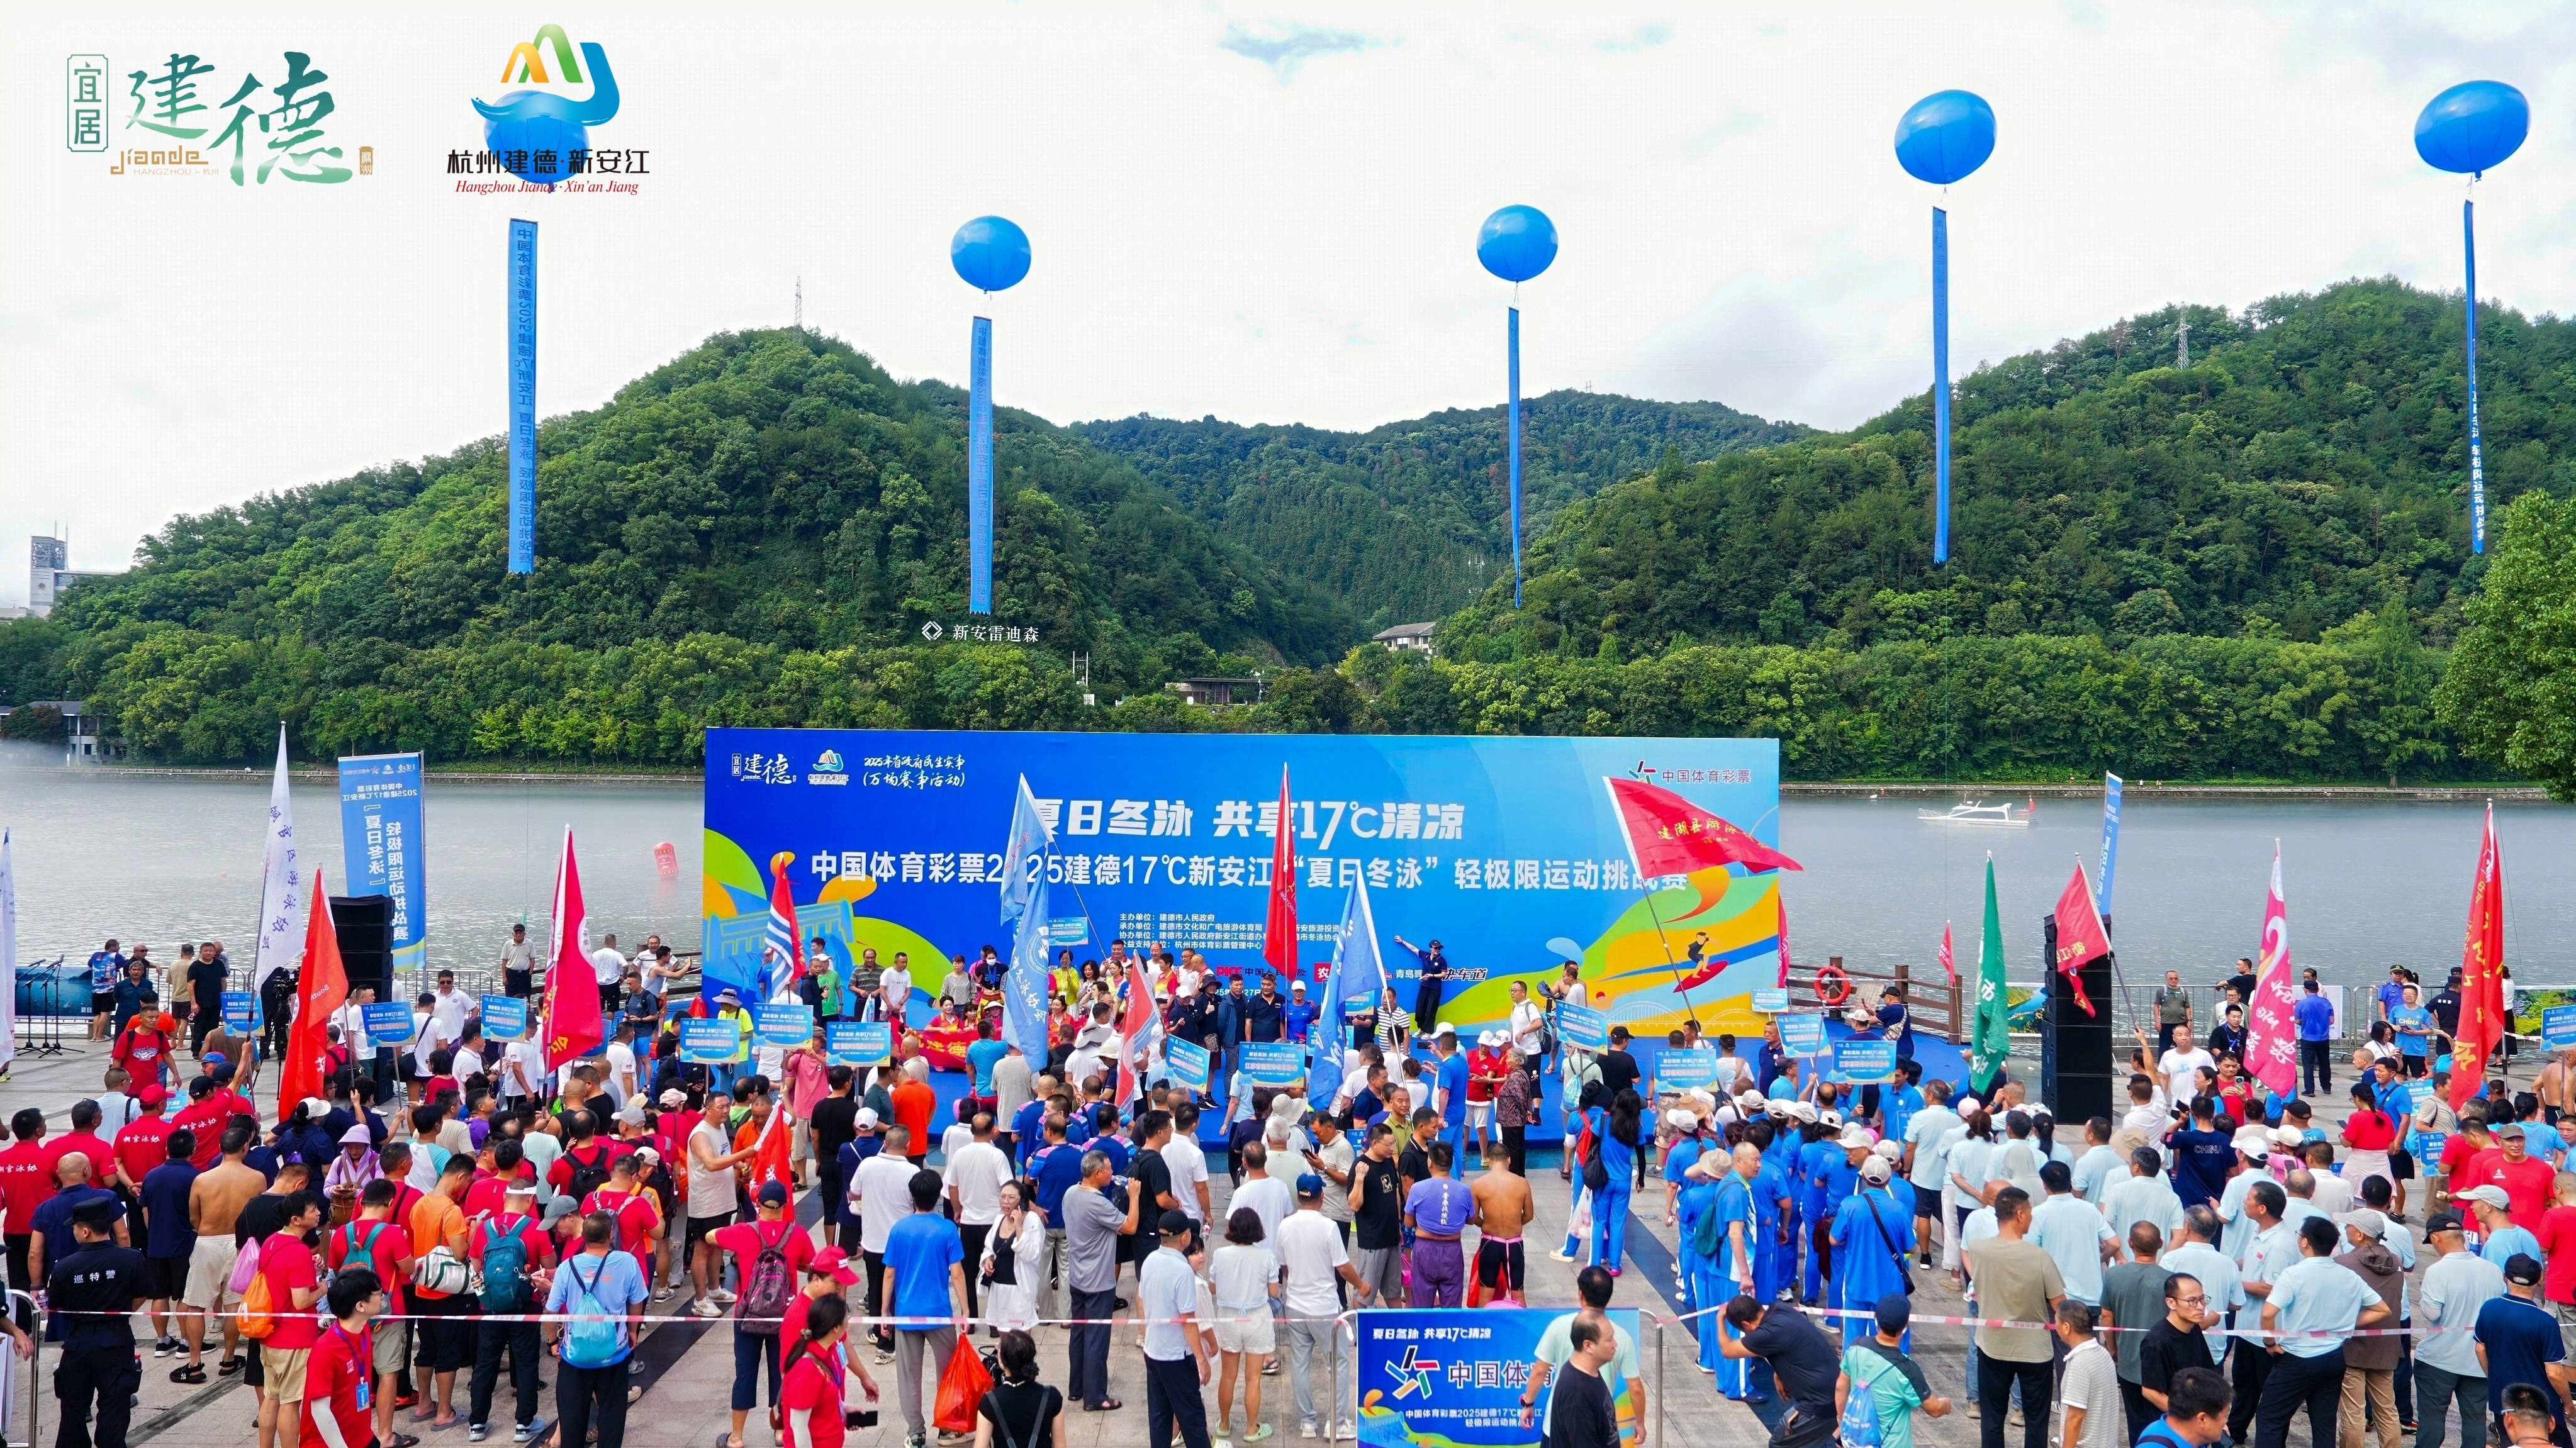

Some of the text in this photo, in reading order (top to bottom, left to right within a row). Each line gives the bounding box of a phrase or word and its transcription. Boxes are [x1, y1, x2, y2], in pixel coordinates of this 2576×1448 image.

[953, 624, 1039, 643] 新安雷迪森
[733, 756, 740, 774] 宜居
[744, 754, 792, 784] 建德
[1661, 769, 1751, 784] 中国体育彩票
[1034, 799, 1193, 837] 夏日冬泳
[1216, 966, 1243, 977] PICC
[2194, 1145, 2224, 1154] CHINA
[74, 1269, 116, 1284] 巡特警
[1373, 1328, 1419, 1340] 夏日冬泳
